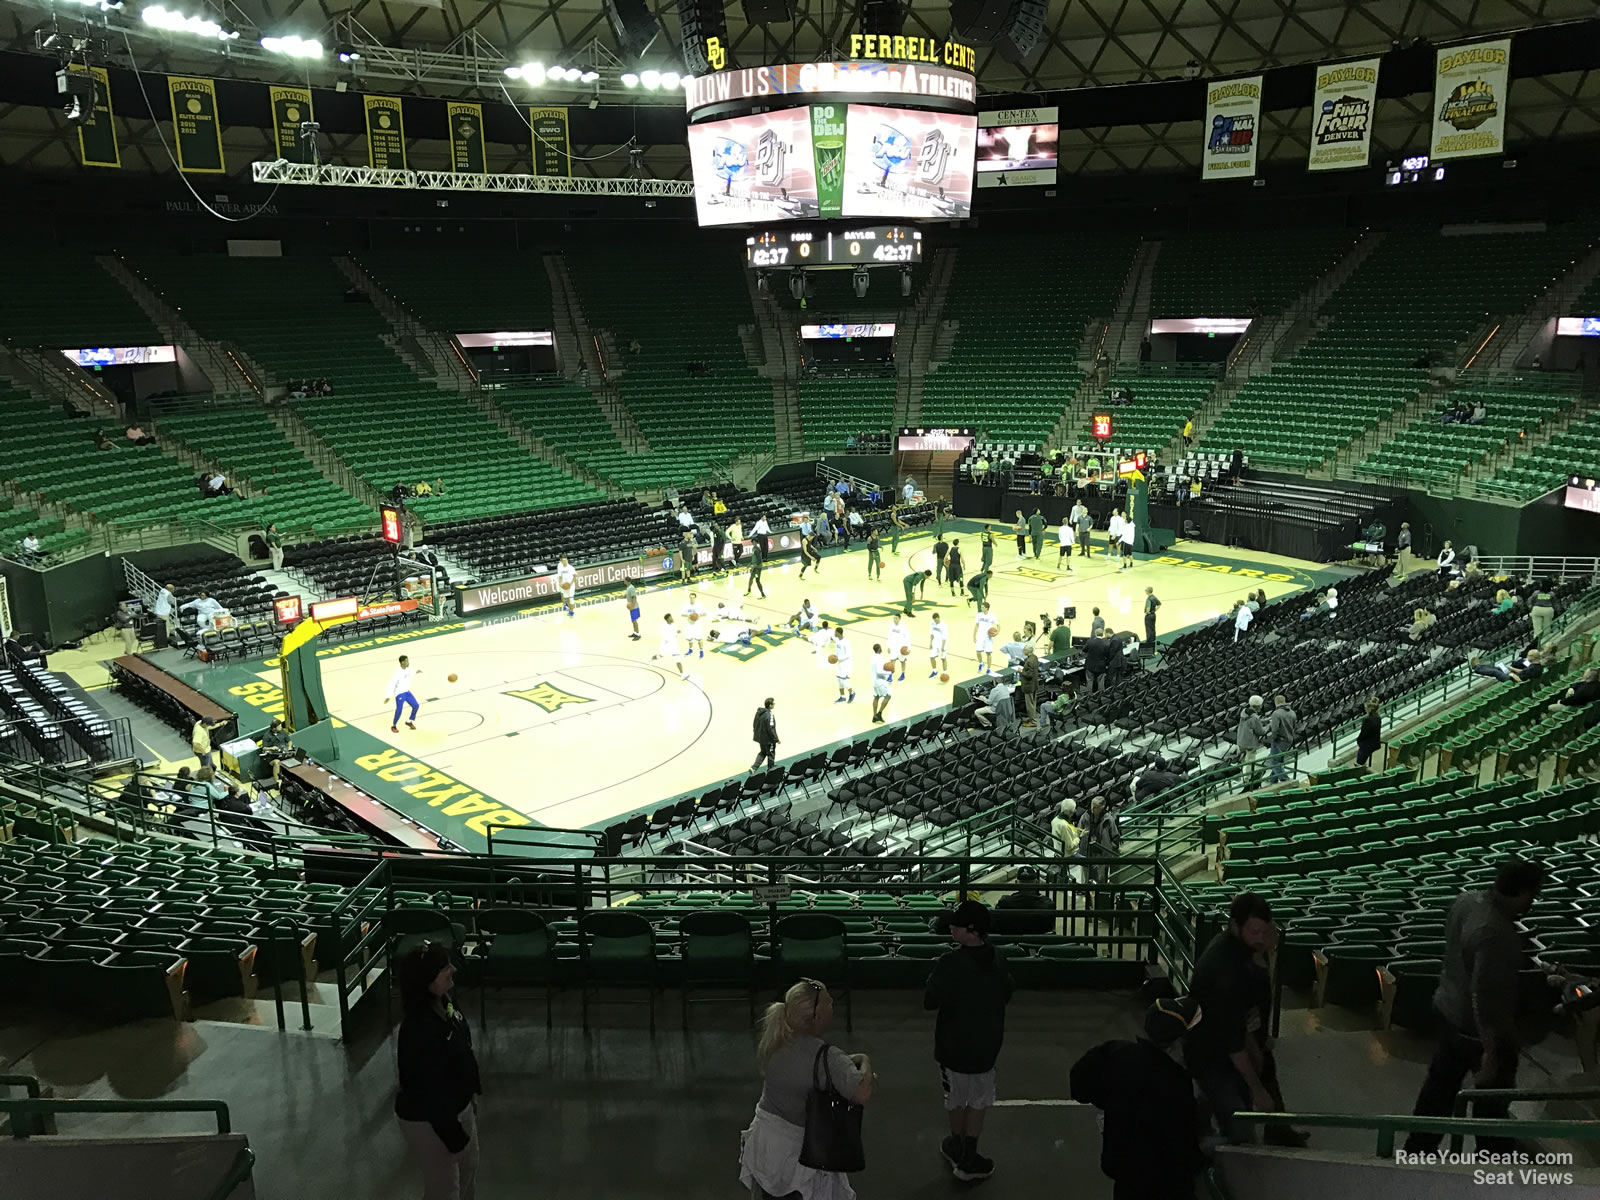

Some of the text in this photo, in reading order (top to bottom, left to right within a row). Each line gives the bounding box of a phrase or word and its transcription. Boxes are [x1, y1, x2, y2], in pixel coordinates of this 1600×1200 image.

[706, 36, 725, 70] BU
[850, 34, 976, 73] FERRELL CENTE
[1439, 48, 1506, 74] BAYLOR
[1318, 66, 1376, 90] BAYLOR
[172, 81, 212, 94] BAYLOR
[688, 72, 731, 107] LLOW
[742, 66, 769, 97] US
[1208, 83, 1260, 105] BAYLOR
[274, 91, 310, 104] BAYLOR
[368, 100, 399, 111] BAYLOR
[450, 106, 480, 117] BAYLOR
[813, 106, 835, 120] DO
[1332, 102, 1367, 118] FINAL
[1445, 102, 1497, 119] FINAL FOUR
[534, 110, 566, 121] BAYLOR
[814, 123, 845, 136] DEW
[1317, 114, 1367, 135] FOUR
[1324, 131, 1359, 142] DENVER
[1441, 131, 1494, 144] NATIONAL
[1435, 139, 1499, 153] CHAMPIONS
[1435, 168, 1445, 180] 0
[166, 202, 194, 212] PAUL
[241, 204, 278, 214] ARENA
[844, 231, 876, 240] BAYLOR
[899, 231, 905, 239] 4
[800, 243, 810, 257] 0
[850, 241, 861, 255] 0
[873, 244, 914, 261] 42:37
[1096, 423, 1109, 435] 30
[915, 442, 958, 450] BASKETBALL
[386, 520, 398, 540] 30
[1151, 556, 1296, 582] BEARS
[479, 585, 532, 607] Welcome
[536, 581, 548, 595] to
[576, 571, 604, 588] errell
[281, 607, 298, 619] 30
[711, 600, 957, 662] BALOR
[263, 619, 481, 667] @aylorAthletics
[354, 749, 533, 838] BAYLOR
